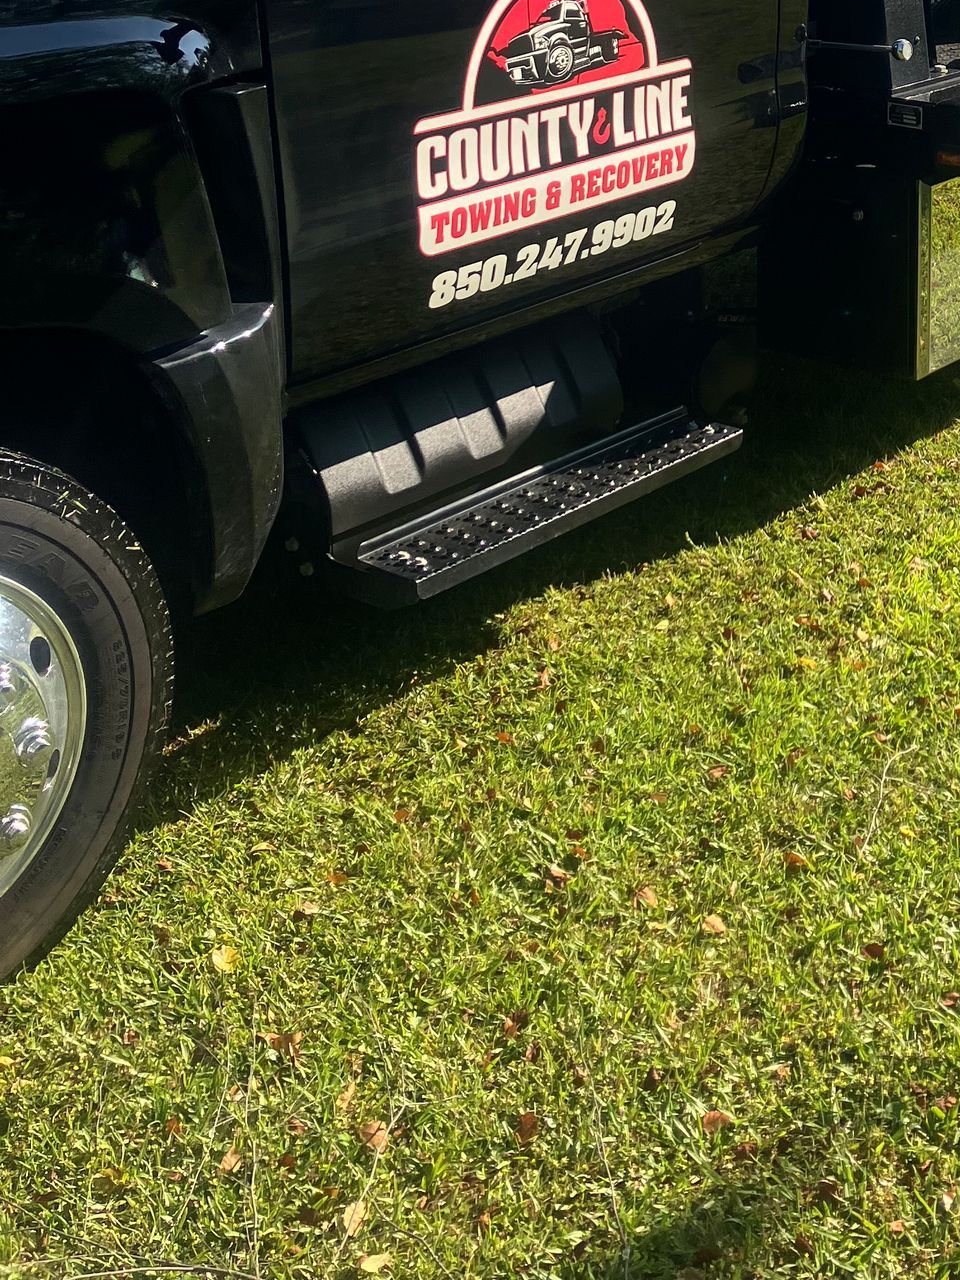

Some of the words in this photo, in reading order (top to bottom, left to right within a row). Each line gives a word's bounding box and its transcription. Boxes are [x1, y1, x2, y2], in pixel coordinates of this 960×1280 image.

[416, 98, 596, 200] COUNTY
[612, 74, 692, 148] LINE
[430, 187, 536, 244] TOWING
[545, 180, 562, 211] &
[570, 143, 689, 204] RECOVERY
[428, 200, 677, 310] 850.247.9902
